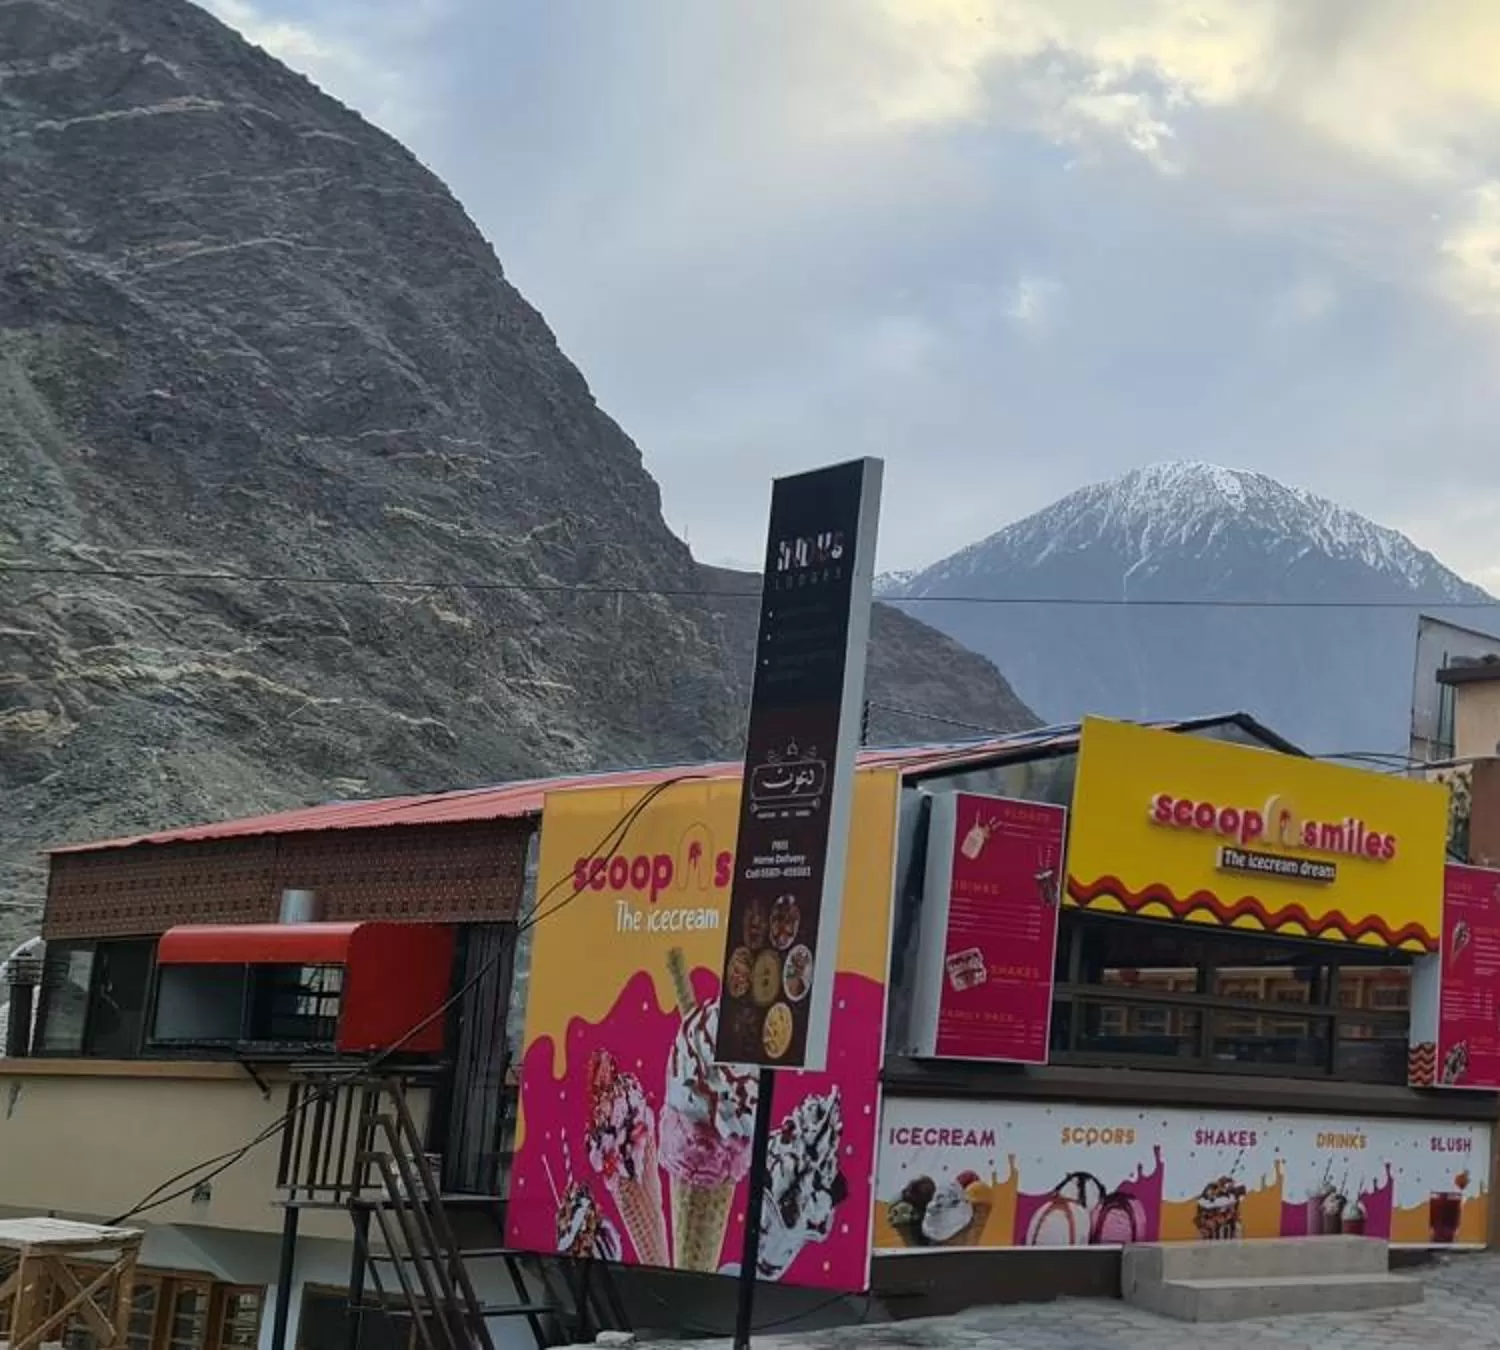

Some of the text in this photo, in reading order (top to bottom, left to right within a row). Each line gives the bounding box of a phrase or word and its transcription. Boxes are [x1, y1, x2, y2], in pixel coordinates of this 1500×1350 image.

[1150, 793, 1397, 864] scoop smiles
[573, 853, 674, 903] scoop
[1224, 848, 1336, 881] The icecream dream
[616, 900, 720, 933] The icecream
[889, 1127, 996, 1148] ICECREAM
[1194, 1129, 1258, 1147] SHAKES
[1315, 1132, 1368, 1150] DRINKS
[1431, 1135, 1472, 1152] SLUSH
